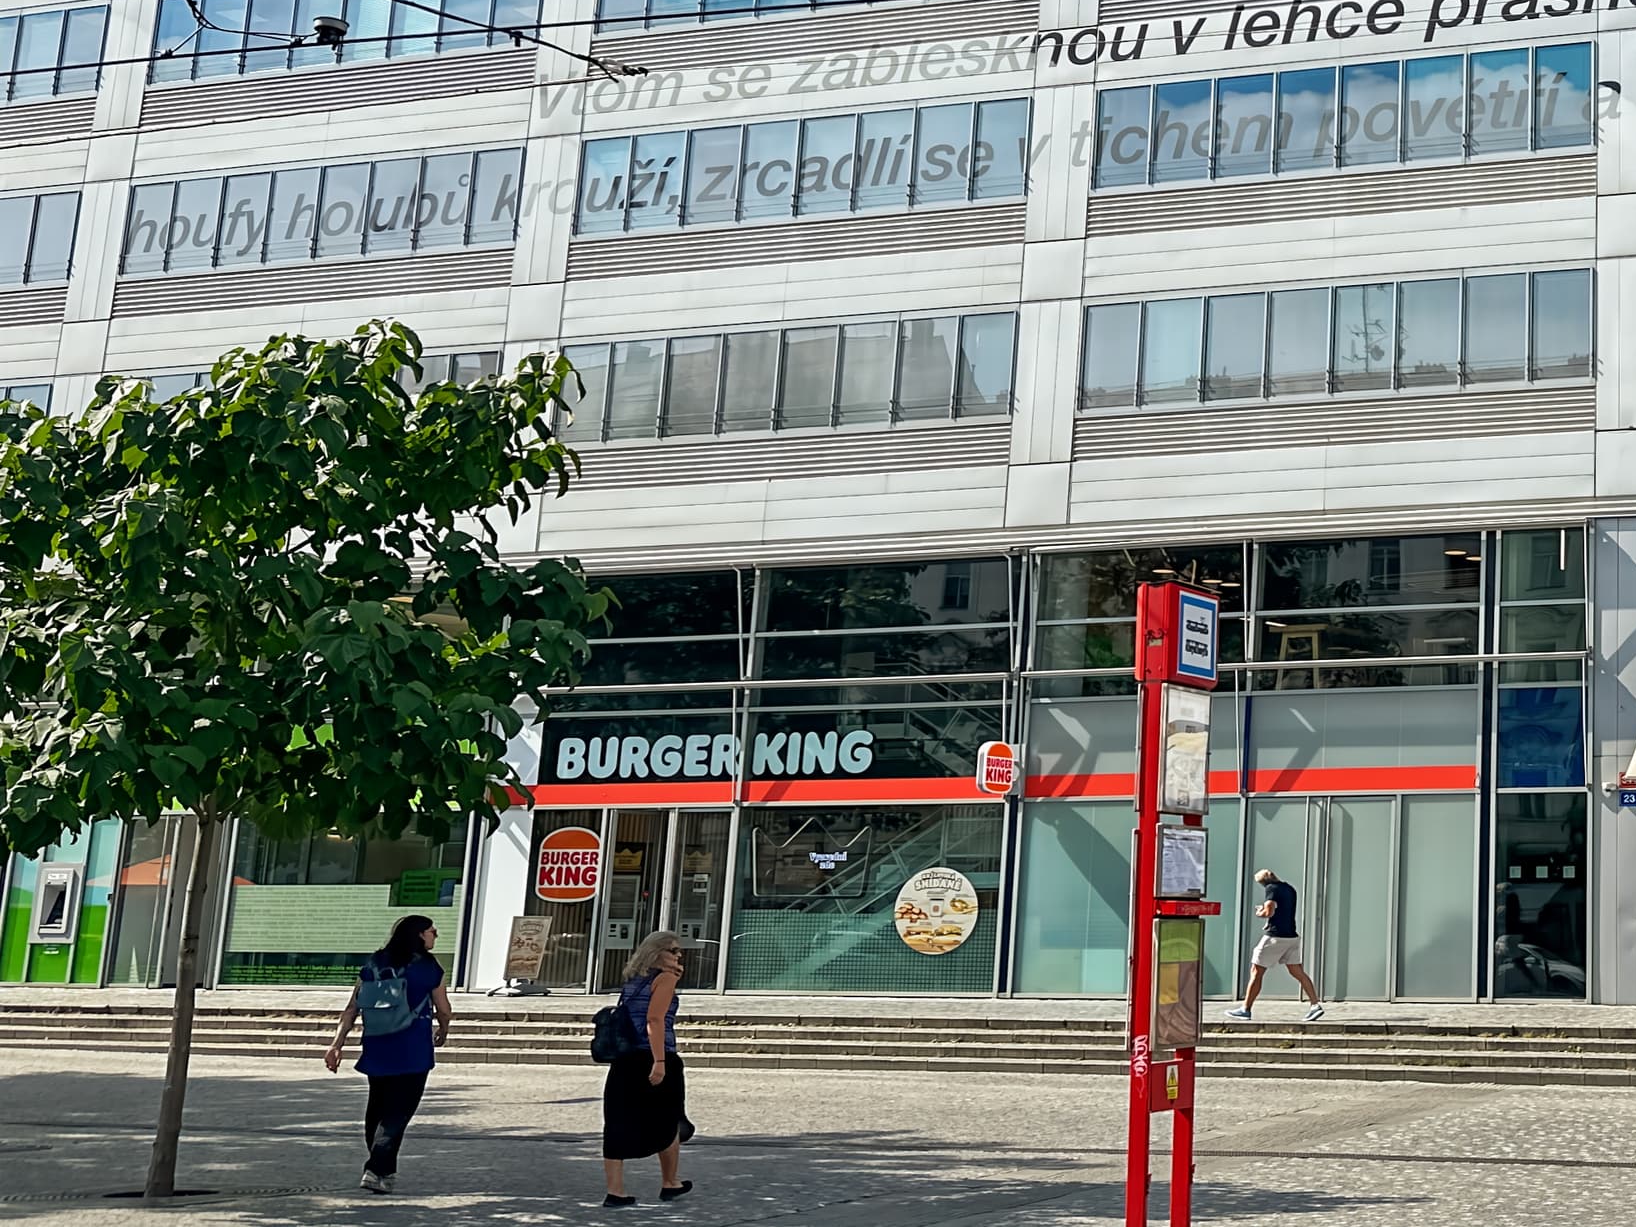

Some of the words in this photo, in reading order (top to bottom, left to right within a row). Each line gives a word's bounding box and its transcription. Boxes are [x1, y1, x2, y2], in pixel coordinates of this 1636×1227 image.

[702, 63, 772, 103] se
[787, 23, 1149, 95] zablesknou
[1171, 17, 1207, 56] v
[129, 197, 275, 256] houfy
[284, 173, 471, 242] holubů
[489, 155, 679, 221] krouží,
[695, 133, 913, 203] zrcadlí
[918, 137, 996, 184] se
[1017, 133, 1052, 169] v
[1070, 102, 1294, 167] tichém
[1315, 70, 1568, 161] povětří
[1582, 80, 1623, 124] a
[556, 733, 741, 779] BURGER
[752, 729, 874, 776] KING
[986, 757, 1013, 769] BURGER
[985, 768, 1012, 783] KING
[1623, 794, 1636, 803] 23
[540, 850, 599, 865] BURGER
[538, 865, 598, 886] KING
